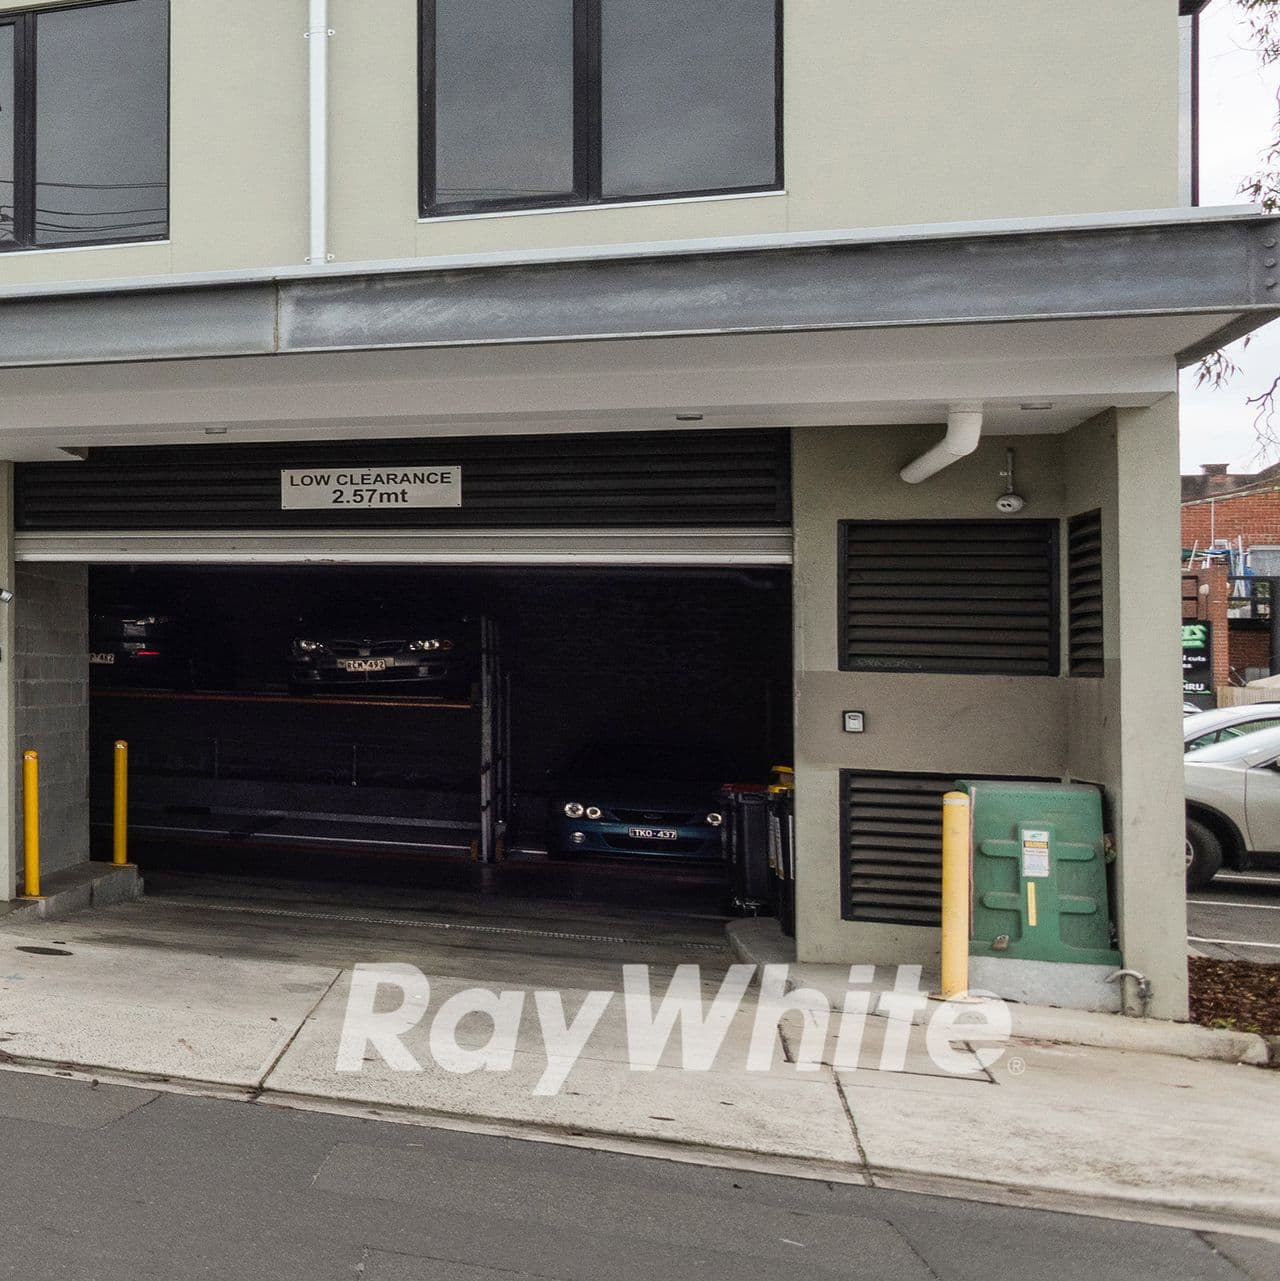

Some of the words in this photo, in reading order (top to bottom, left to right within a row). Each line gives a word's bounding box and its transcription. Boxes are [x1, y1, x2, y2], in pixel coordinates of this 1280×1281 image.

[290, 474, 331, 487] LOW
[336, 472, 452, 486] CLEARANCE
[332, 488, 408, 504] 2.57mt
